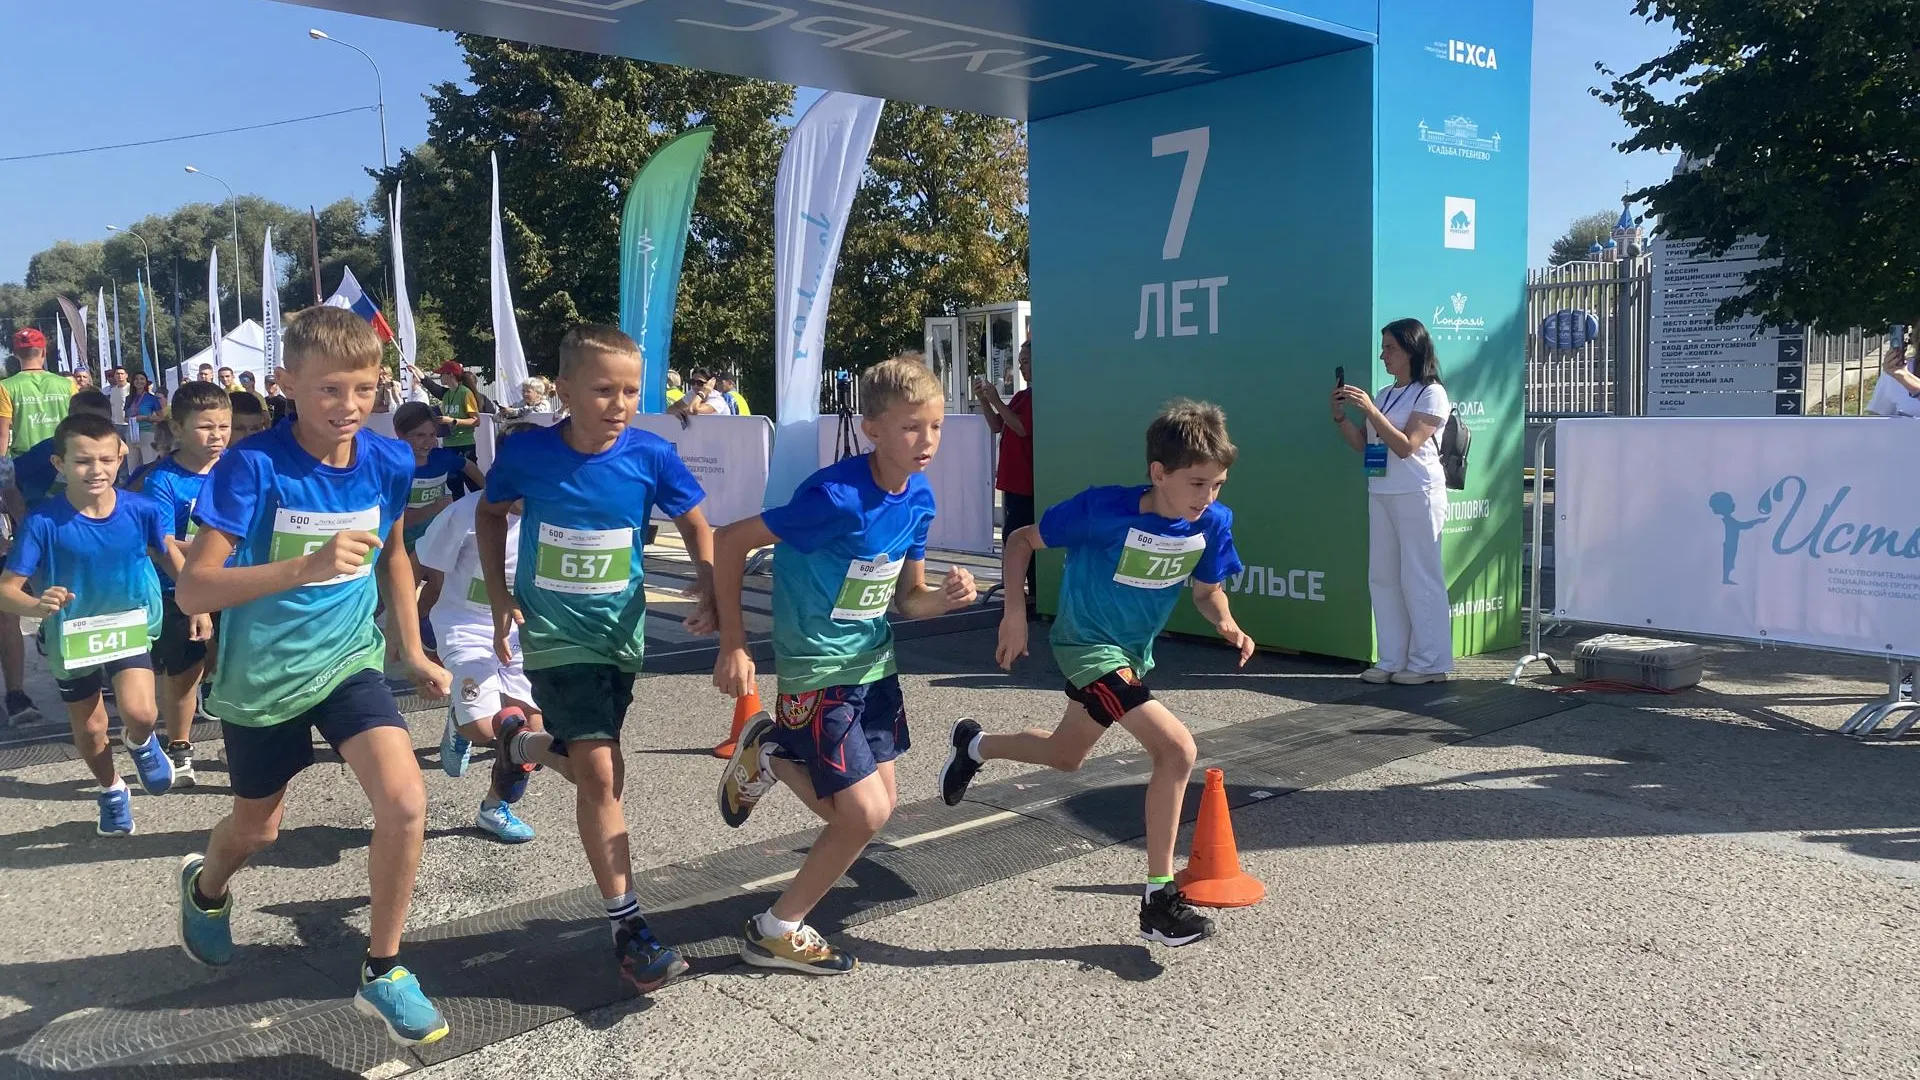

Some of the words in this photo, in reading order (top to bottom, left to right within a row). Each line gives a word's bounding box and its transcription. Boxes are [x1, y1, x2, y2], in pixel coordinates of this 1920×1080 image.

[1151, 126, 1210, 261] 7
[1134, 275, 1229, 340] ЛЕТ
[1683, 343, 1699, 351] ДЛЯ
[1700, 341, 1757, 350] СПОРТСМЕНОВ
[290, 515, 310, 525] 600
[548, 529, 564, 539] 600
[1137, 534, 1153, 544] 600
[560, 553, 613, 579] 637
[859, 564, 875, 573] 600
[1146, 556, 1185, 577] 715
[1219, 564, 1326, 602] УЛЬСЕ
[1449, 596, 1504, 618] НАПУЛЬСЕ
[88, 630, 128, 654] 641
